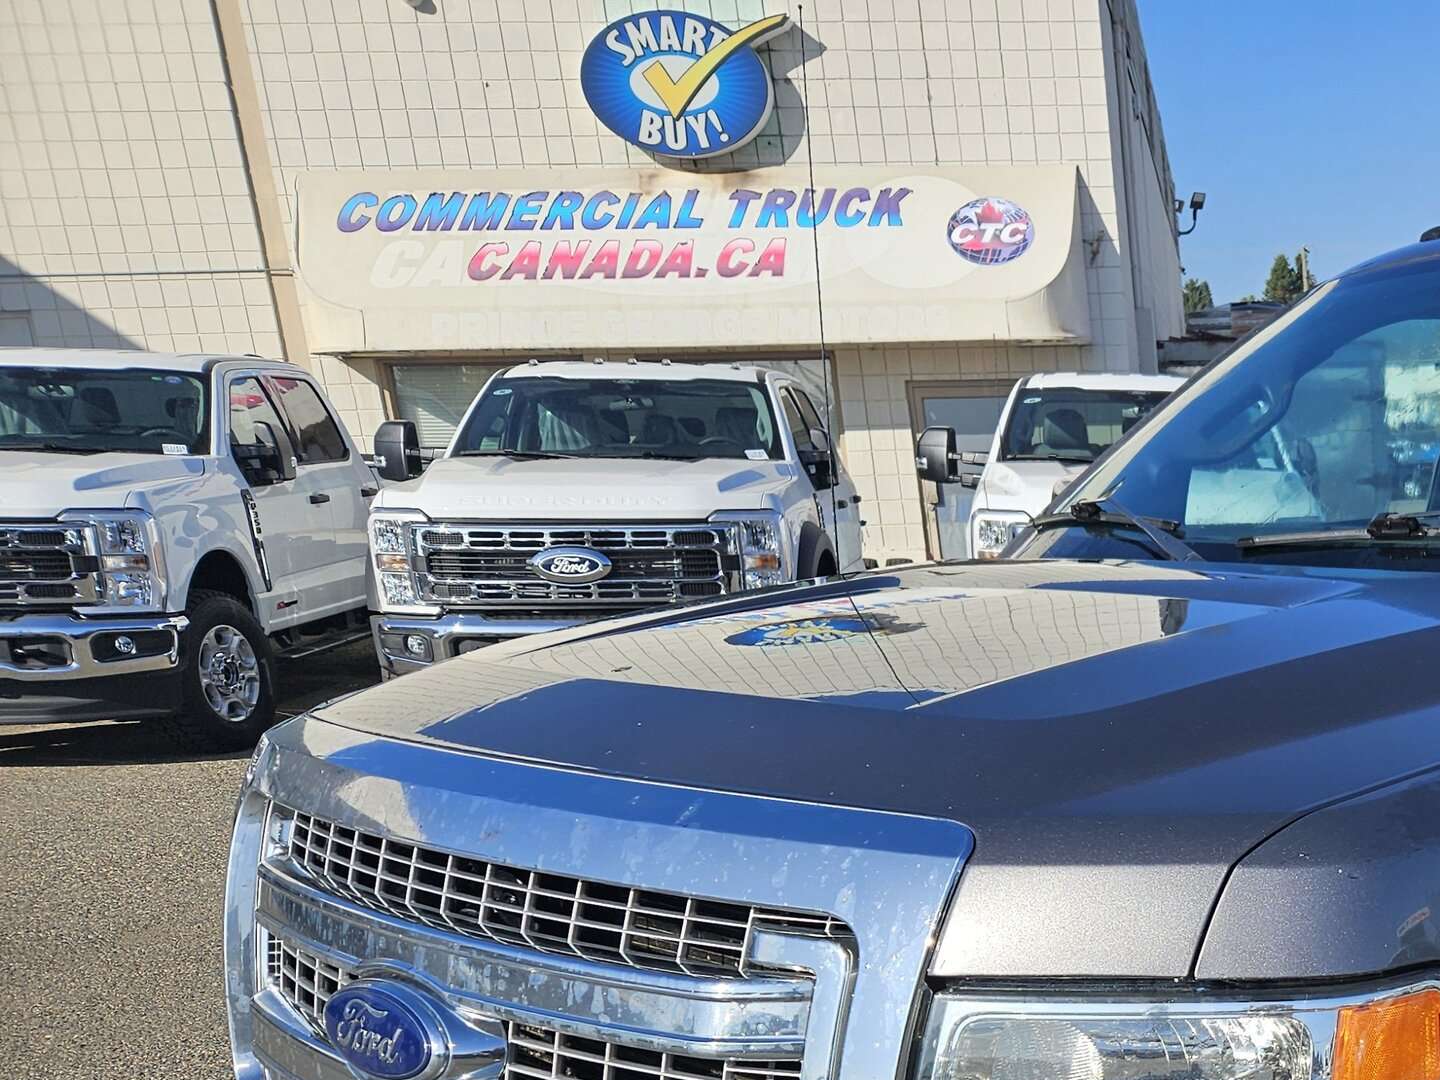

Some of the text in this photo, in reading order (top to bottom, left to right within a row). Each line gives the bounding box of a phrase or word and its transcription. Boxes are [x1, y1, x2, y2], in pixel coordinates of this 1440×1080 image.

[605, 15, 730, 67] SMART
[638, 109, 730, 150] BUY!
[336, 187, 914, 233] COMMERCIAL TRUCK
[949, 221, 1029, 244] CTC
[466, 236, 788, 281] CANADA.CA
[550, 556, 591, 574] Ford
[337, 998, 404, 1064] Ford
